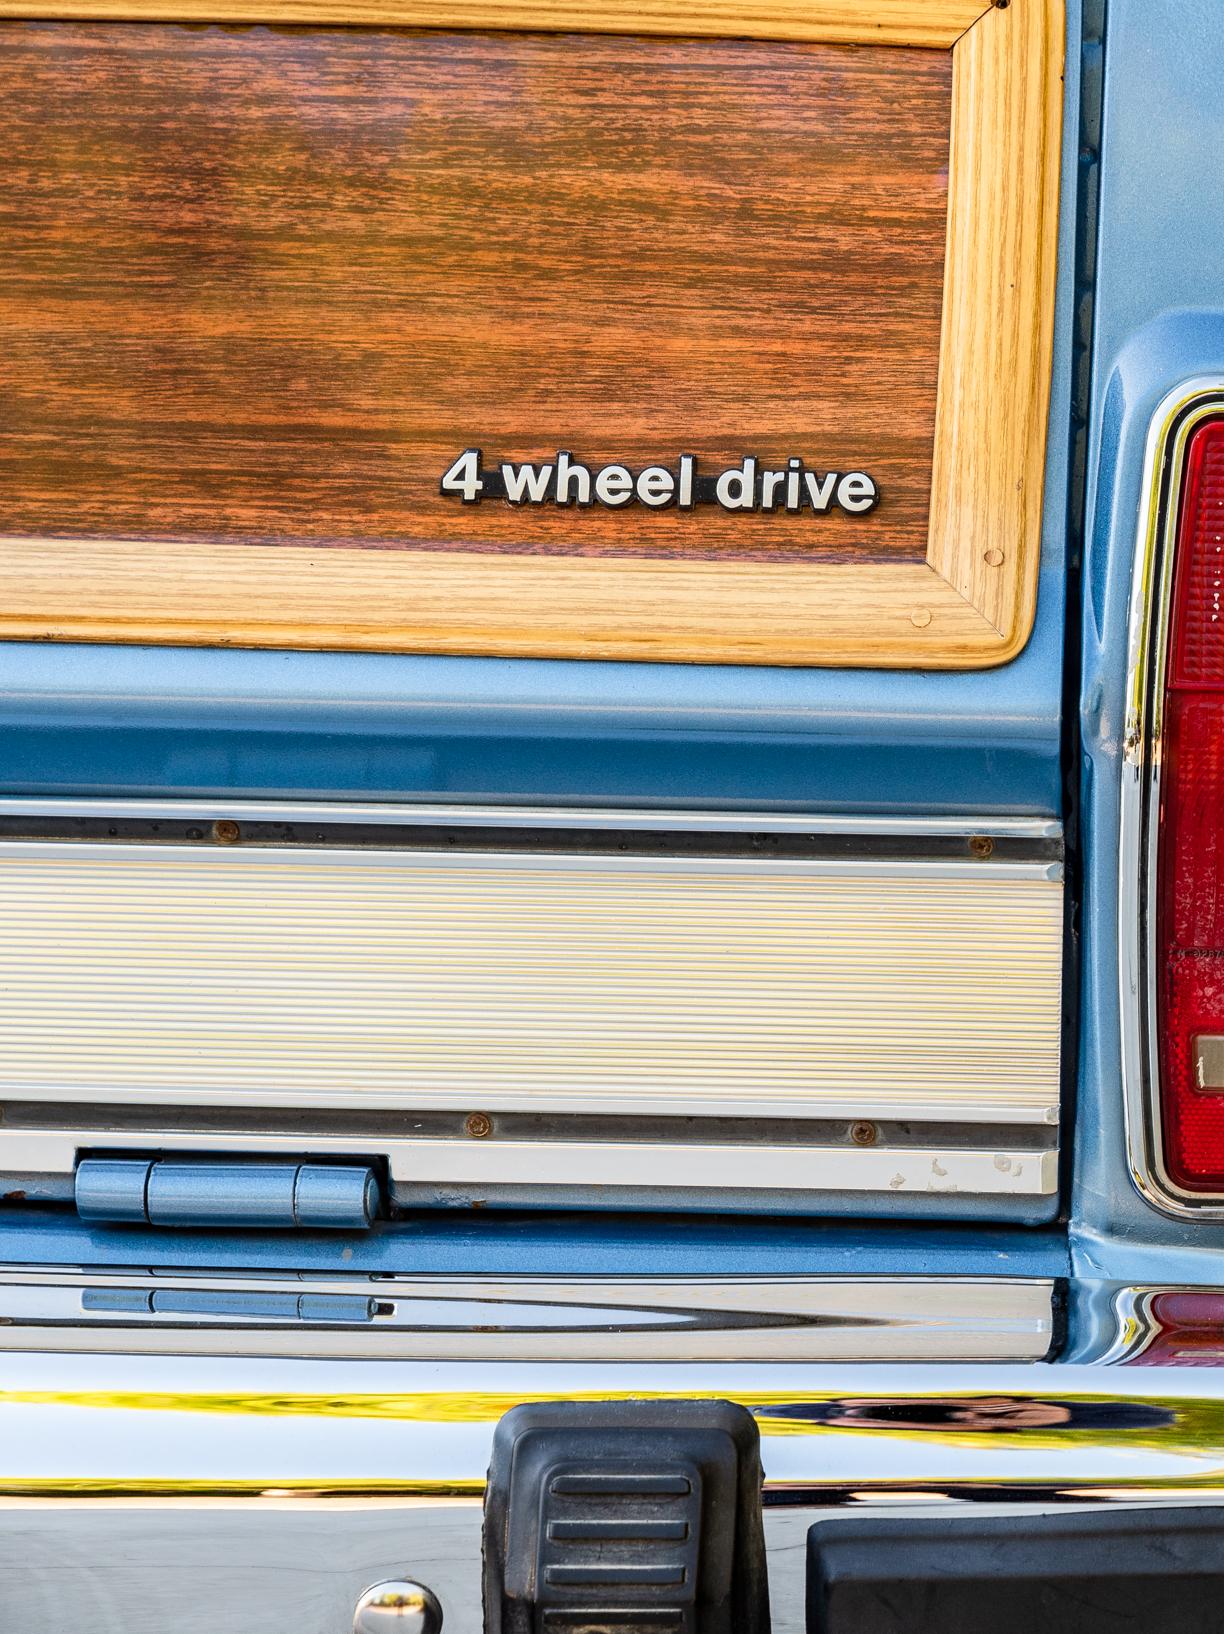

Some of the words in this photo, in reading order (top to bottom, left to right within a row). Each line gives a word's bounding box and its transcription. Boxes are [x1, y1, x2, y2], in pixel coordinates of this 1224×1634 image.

[441, 450, 484, 502] 4
[501, 451, 697, 507] wheel
[715, 456, 877, 514] drive
